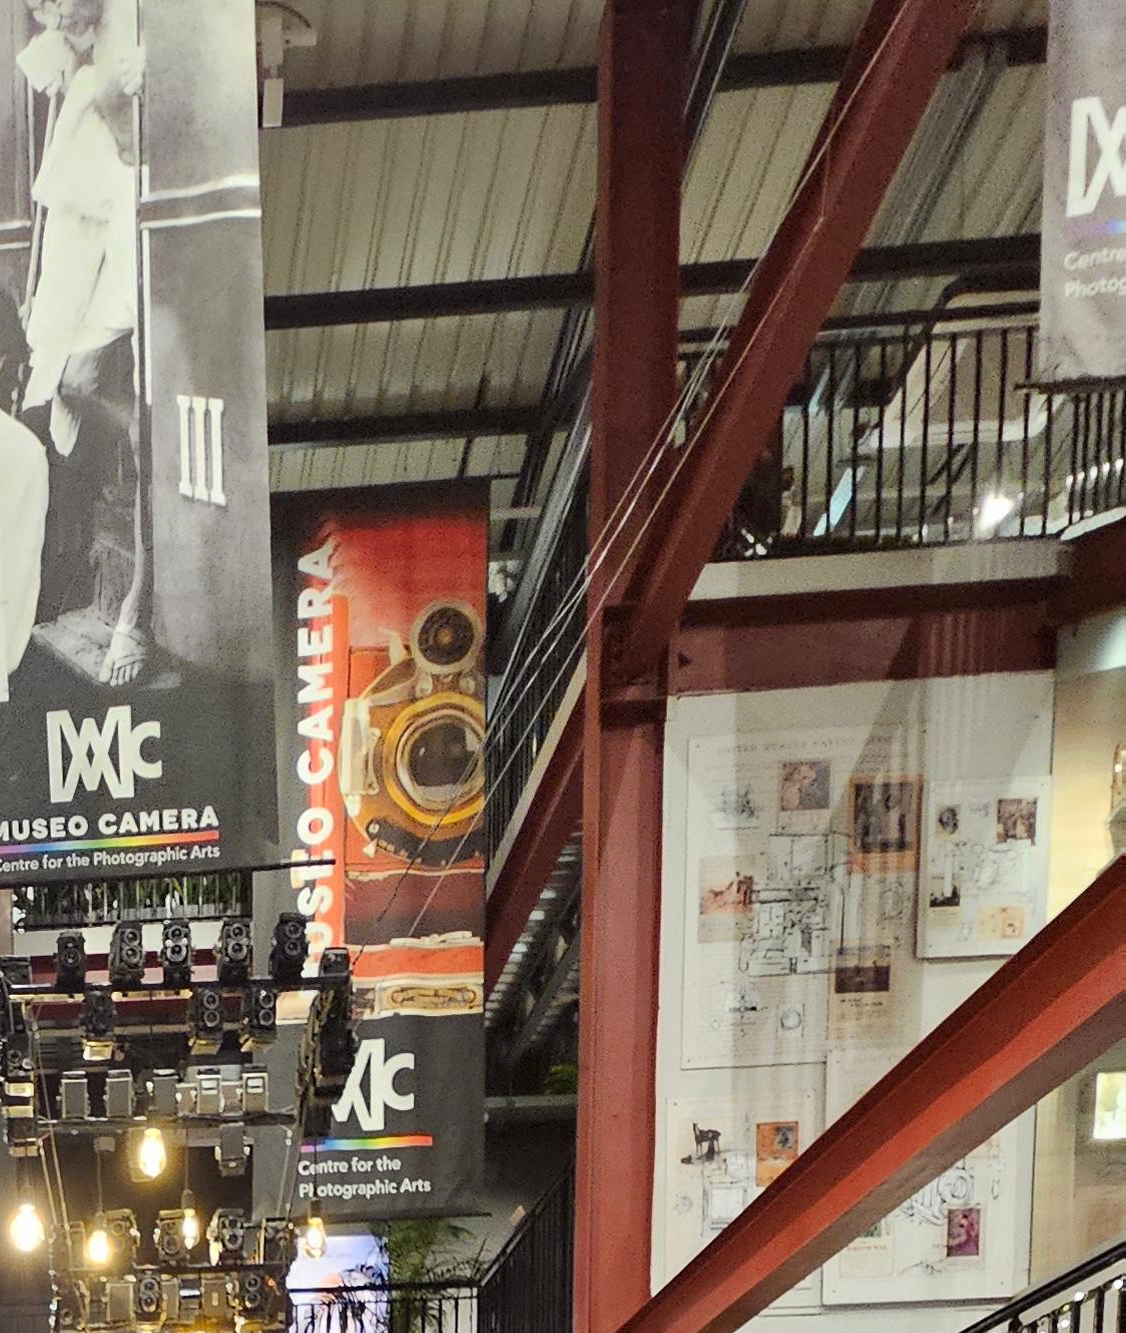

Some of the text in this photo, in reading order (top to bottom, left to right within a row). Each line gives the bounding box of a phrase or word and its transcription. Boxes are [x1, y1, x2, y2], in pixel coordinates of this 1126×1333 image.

[292, 540, 337, 978] USEO CAMERA
[97, 805, 220, 835] CAMERA
[42, 854, 63, 870] for
[66, 852, 90, 868] the
[93, 847, 188, 868] Photographic
[190, 844, 221, 859] Arts
[298, 1155, 402, 1176] Centre for the
[400, 1177, 432, 1194] Arts
